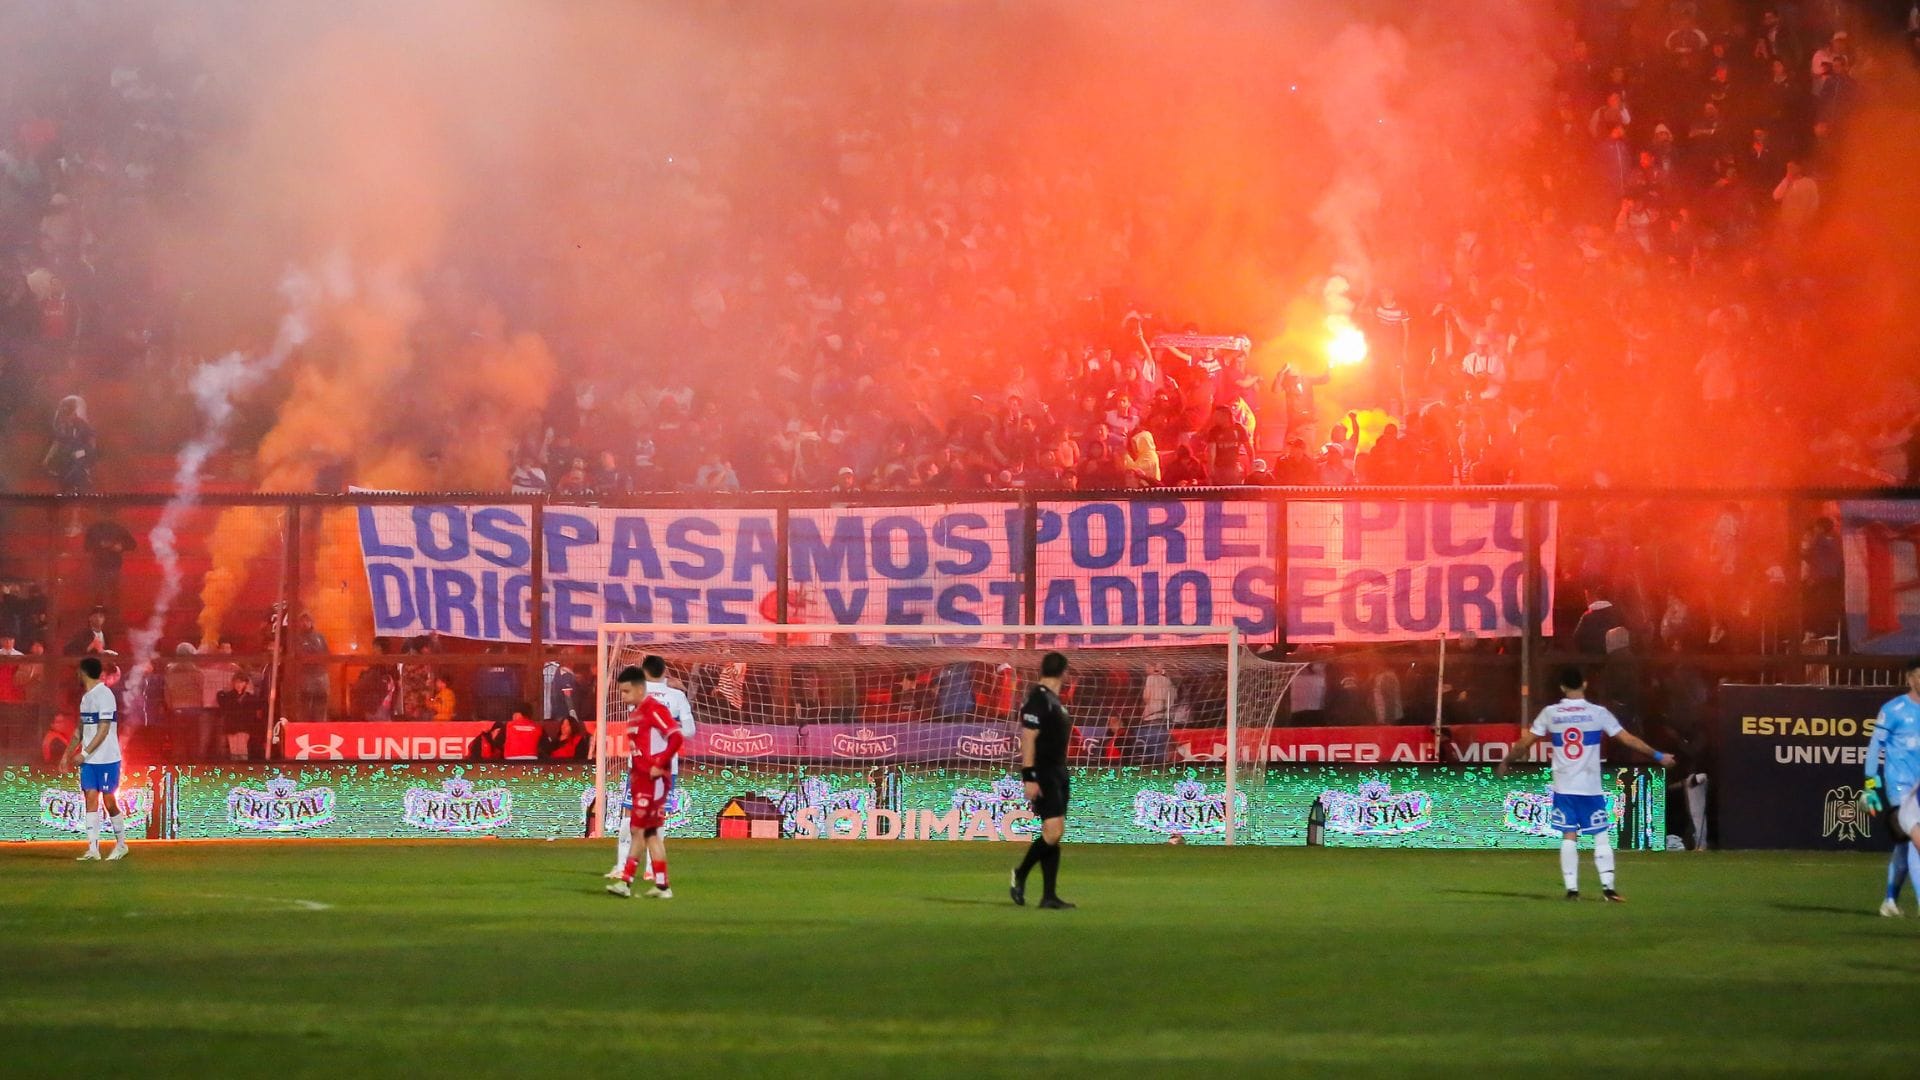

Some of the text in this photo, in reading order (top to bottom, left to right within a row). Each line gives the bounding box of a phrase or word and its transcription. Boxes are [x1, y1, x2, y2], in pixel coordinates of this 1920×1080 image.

[358, 501, 1549, 582] LOS PASAMOS POR EL PICO
[368, 561, 1549, 647] DIRIGENTE Y ESTADIO SEGURO
[1742, 716, 1879, 736] ESTADIO S
[358, 737, 471, 760] UNDE
[712, 738, 768, 755] CRISTAL
[837, 738, 891, 755] CRISTAL
[962, 741, 1014, 756] CRISTAL
[1243, 743, 1380, 762] UNDER
[1563, 726, 1585, 761] 8
[1775, 745, 1886, 765] UNIVERS
[236, 796, 326, 820] CRISTAL
[415, 798, 502, 821] RISTAL
[1147, 801, 1226, 823] RISTA
[795, 807, 1034, 841] SODIMAC
